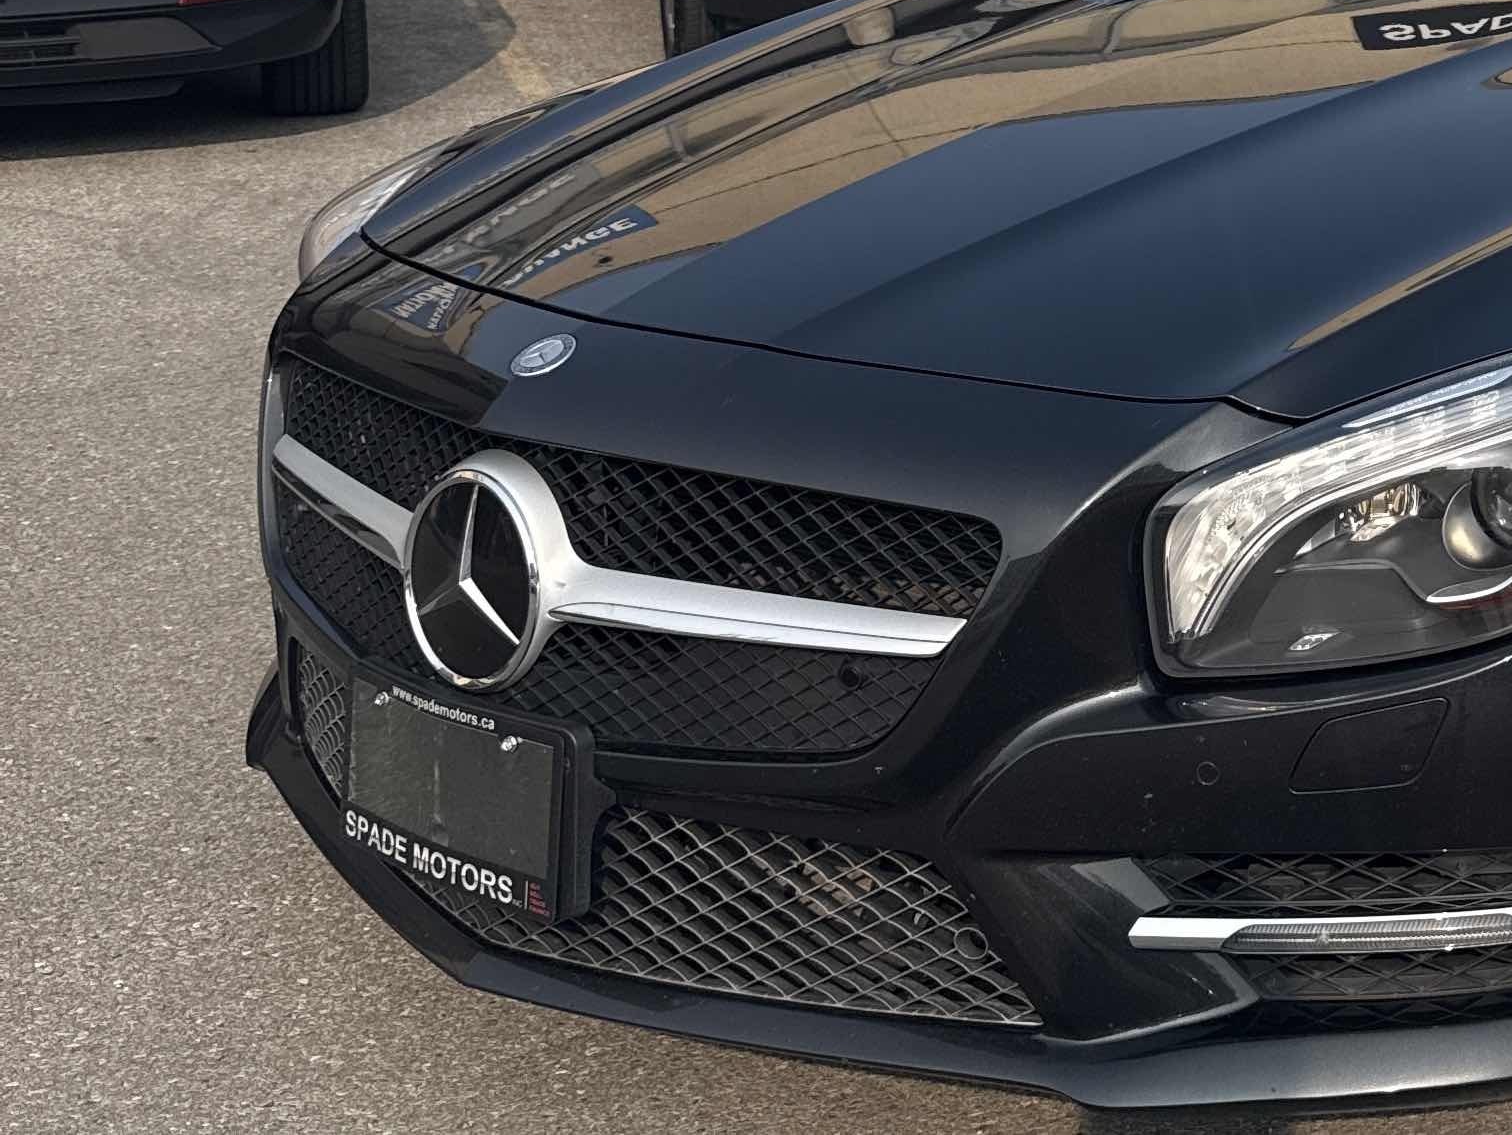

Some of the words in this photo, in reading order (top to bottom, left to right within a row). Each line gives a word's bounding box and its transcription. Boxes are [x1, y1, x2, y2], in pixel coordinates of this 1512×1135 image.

[391, 684, 496, 731] www.spademotors.ca
[345, 809, 409, 865] SPADE
[412, 842, 514, 905] MOTORS
